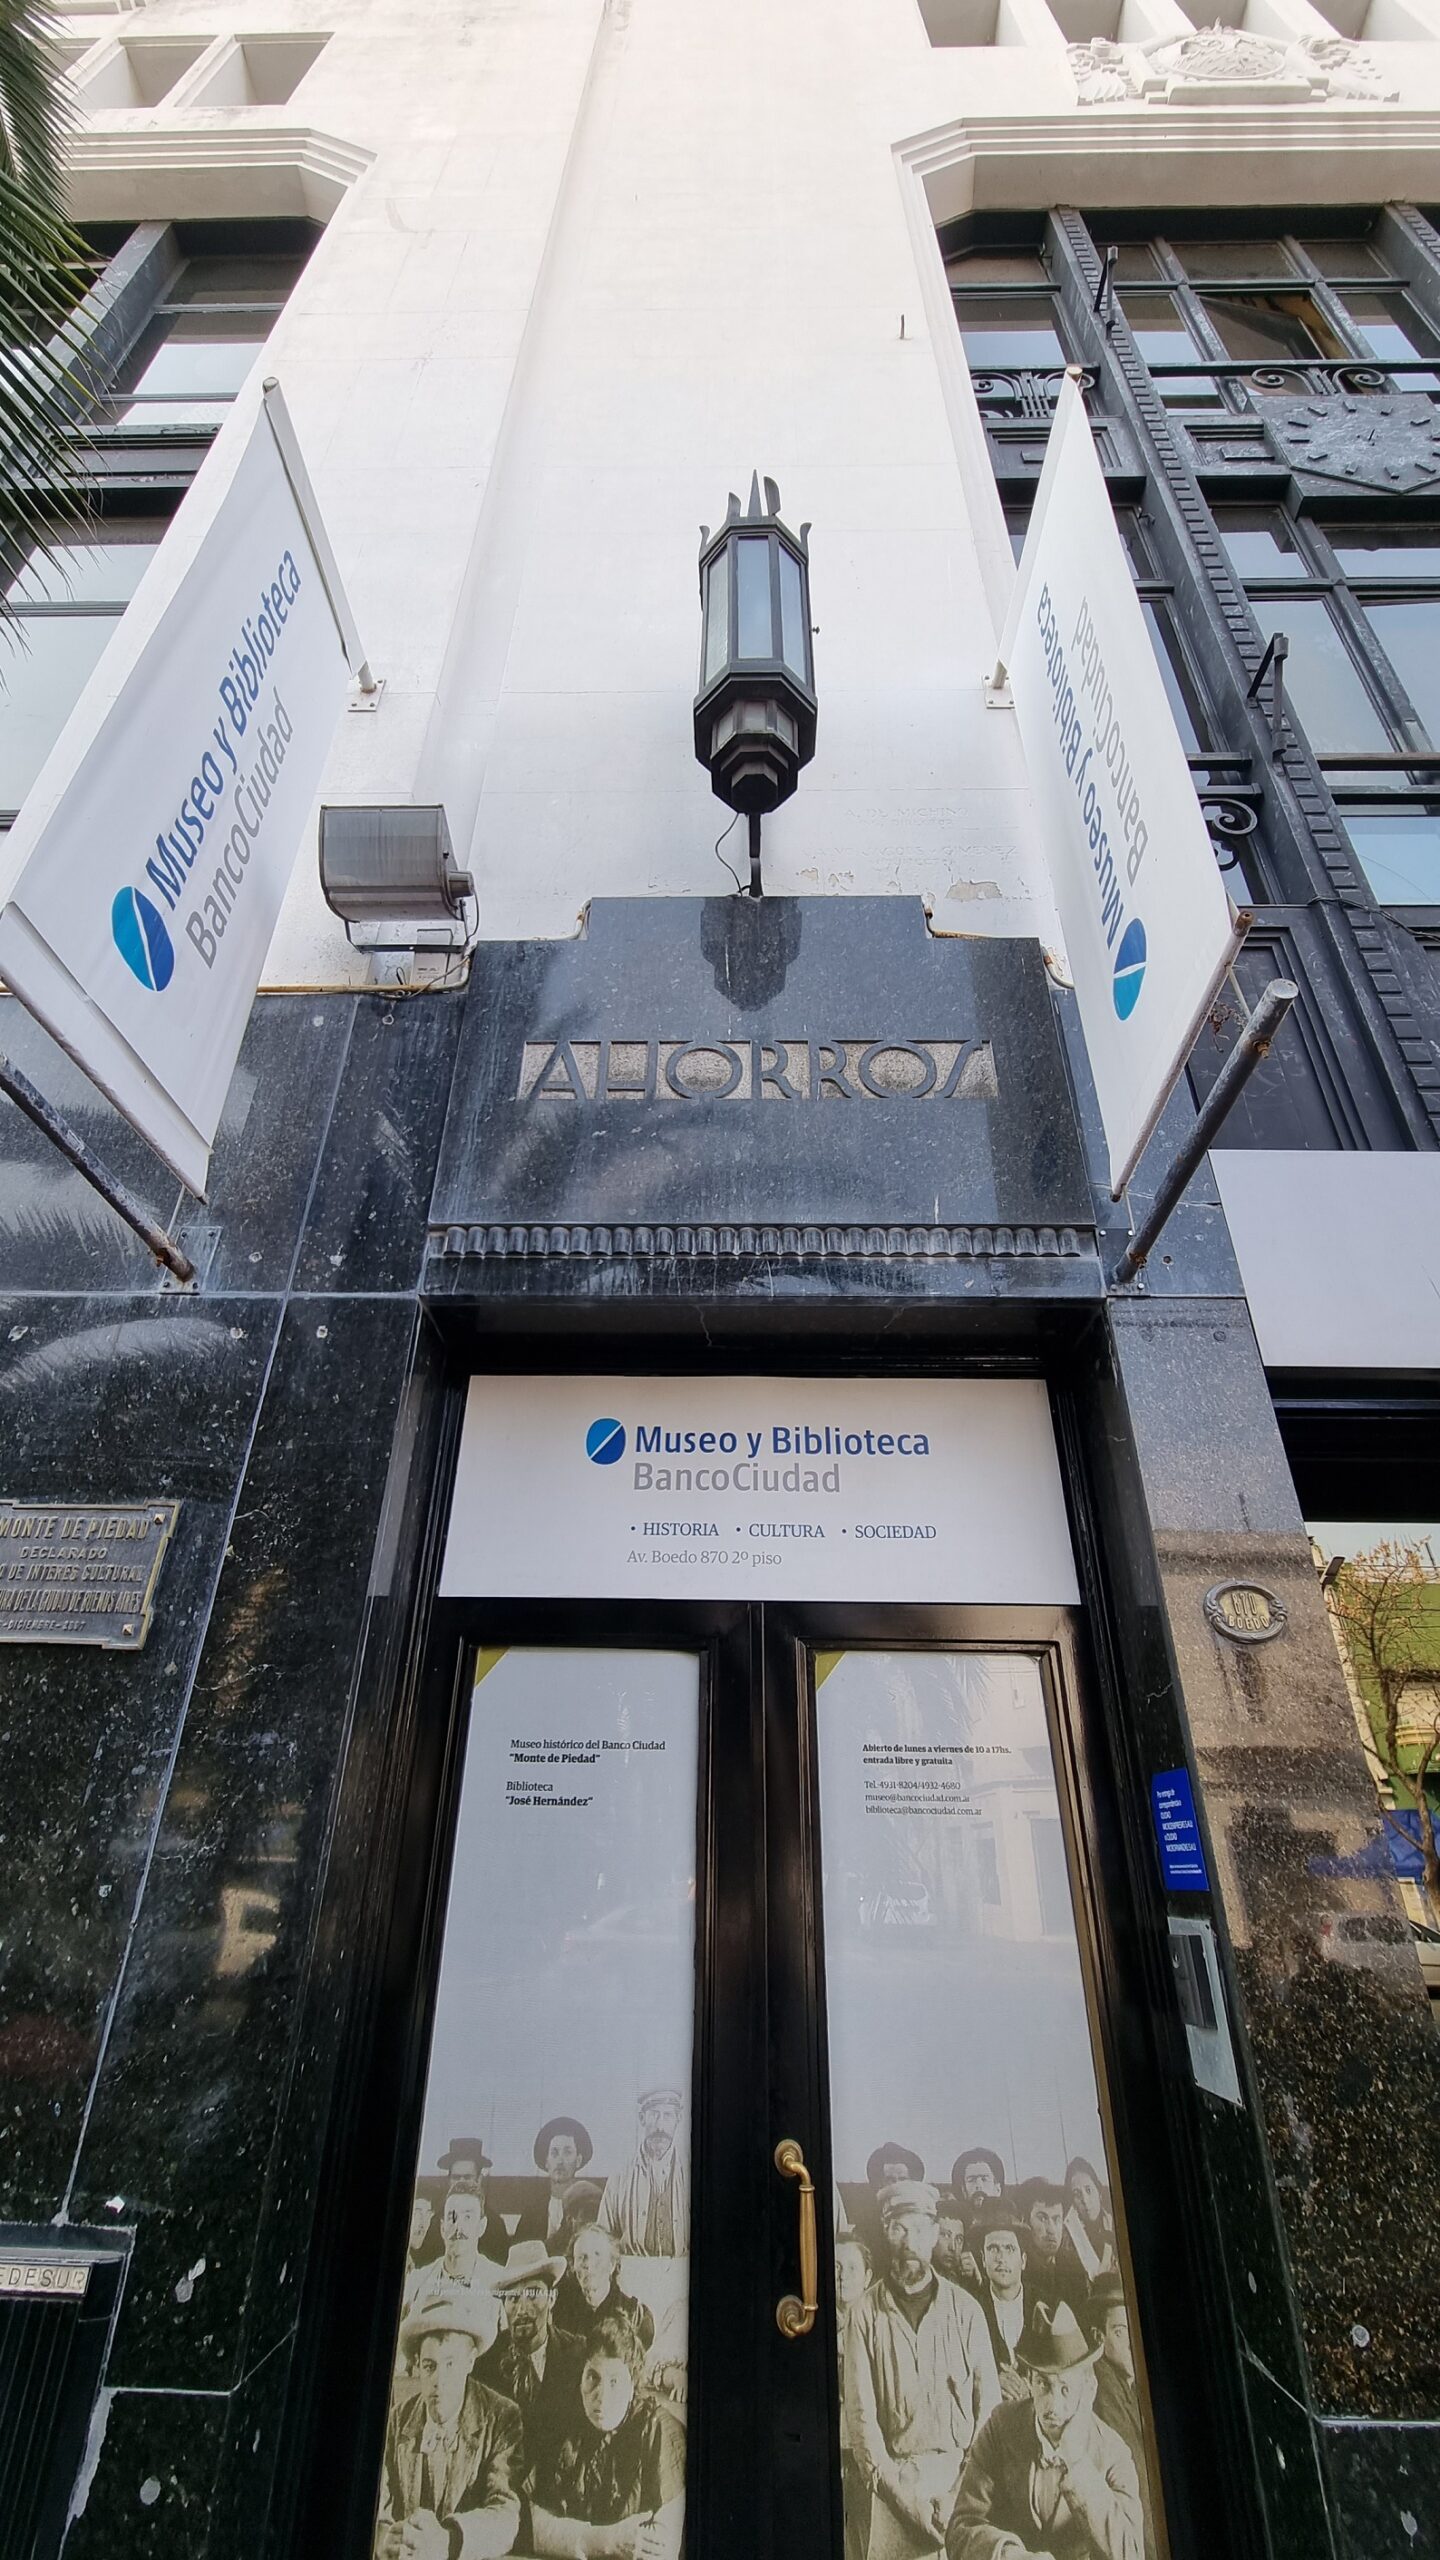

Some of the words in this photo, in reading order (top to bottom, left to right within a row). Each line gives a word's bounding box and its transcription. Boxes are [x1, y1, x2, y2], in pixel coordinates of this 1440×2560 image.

[219, 549, 302, 737] Biblioteca
[1037, 581, 1083, 779] Biblioteca
[213, 716, 238, 775] y
[1071, 595, 1148, 888] BancoCiudad
[1075, 747, 1095, 798] y
[146, 751, 224, 911] Museo
[185, 686, 293, 969] BancoCiudad
[1083, 787, 1124, 950] Museo
[527, 1039, 985, 1100] AHORROS
[635, 1426, 737, 1453] Museo
[747, 1431, 762, 1458] y
[772, 1426, 930, 1456] Biblioteca
[633, 1462, 841, 1493] BancoCiudad
[0, 1516, 58, 1538] MONTE
[60, 1517, 85, 1539] DE
[85, 1517, 150, 1540] PIEDAD
[643, 1523, 720, 1537] HISTORIA
[749, 1524, 825, 1538] CULTURA
[855, 1525, 937, 1539] SOCIEDAD
[20, 1546, 108, 1560] DECLARADO
[627, 1550, 648, 1564] Av.
[652, 1550, 697, 1564] Boedo
[700, 1551, 728, 1565] 870
[752, 1551, 782, 1567] piso
[81, 1565, 146, 1583] CULTURAL
[1231, 1592, 1257, 1615] 870
[1228, 1615, 1270, 1630] BOEDO
[510, 1739, 541, 1749] Museo
[543, 1739, 584, 1749] histórico
[585, 1739, 600, 1749] del
[601, 1740, 631, 1750] Banco
[632, 1740, 666, 1750] Ciudad
[863, 1744, 892, 1752] Abierto
[893, 1744, 904, 1753] de
[904, 1745, 926, 1753] lunes
[933, 1745, 963, 1754] viernes
[964, 1745, 975, 1754] de
[547, 1753, 560, 1763] de
[863, 1756, 894, 1764] entrada
[895, 1756, 914, 1765] libre
[921, 1757, 953, 1766] gratuita
[506, 1781, 553, 1791] Biblioteca
